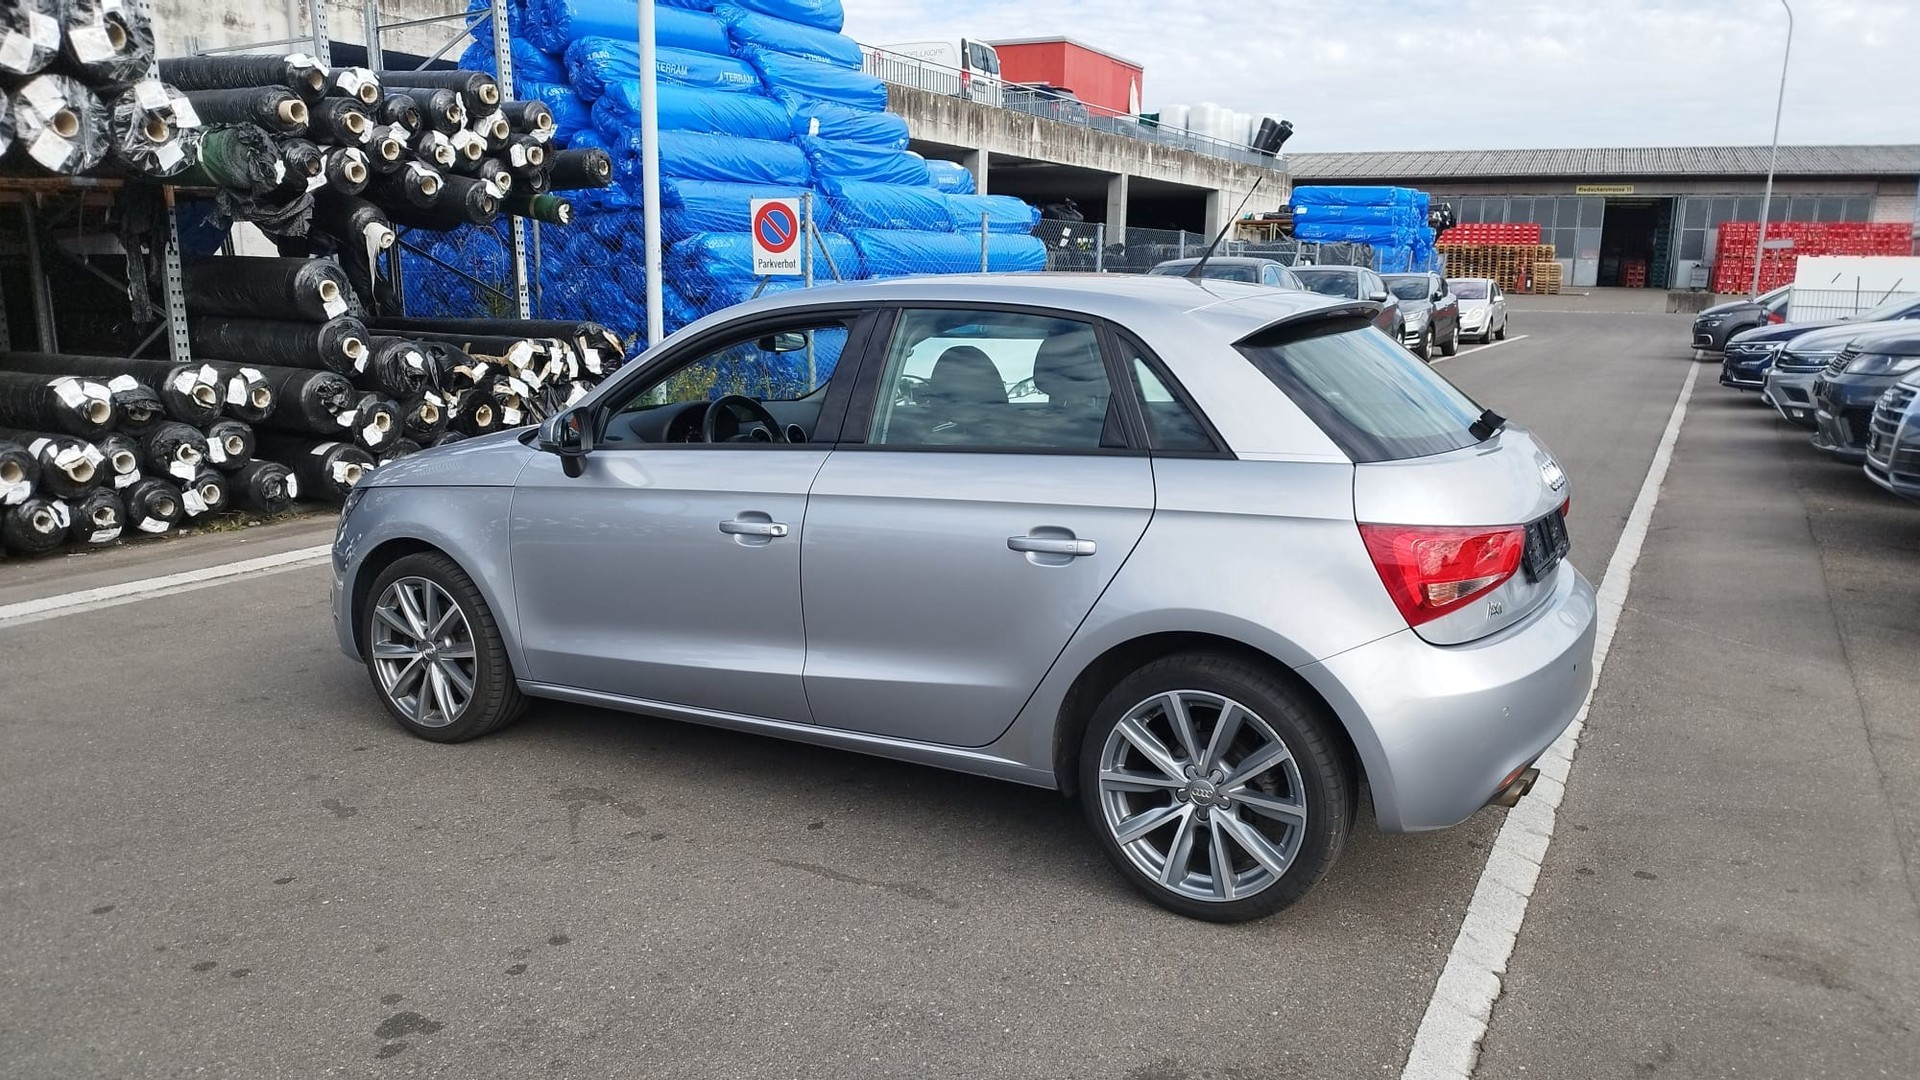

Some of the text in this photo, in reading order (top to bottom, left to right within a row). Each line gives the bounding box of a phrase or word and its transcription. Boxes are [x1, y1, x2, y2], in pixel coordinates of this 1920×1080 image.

[656, 61, 688, 75] TERRAM
[724, 72, 754, 84] TERRAM
[758, 258, 796, 269] Parkverbot
